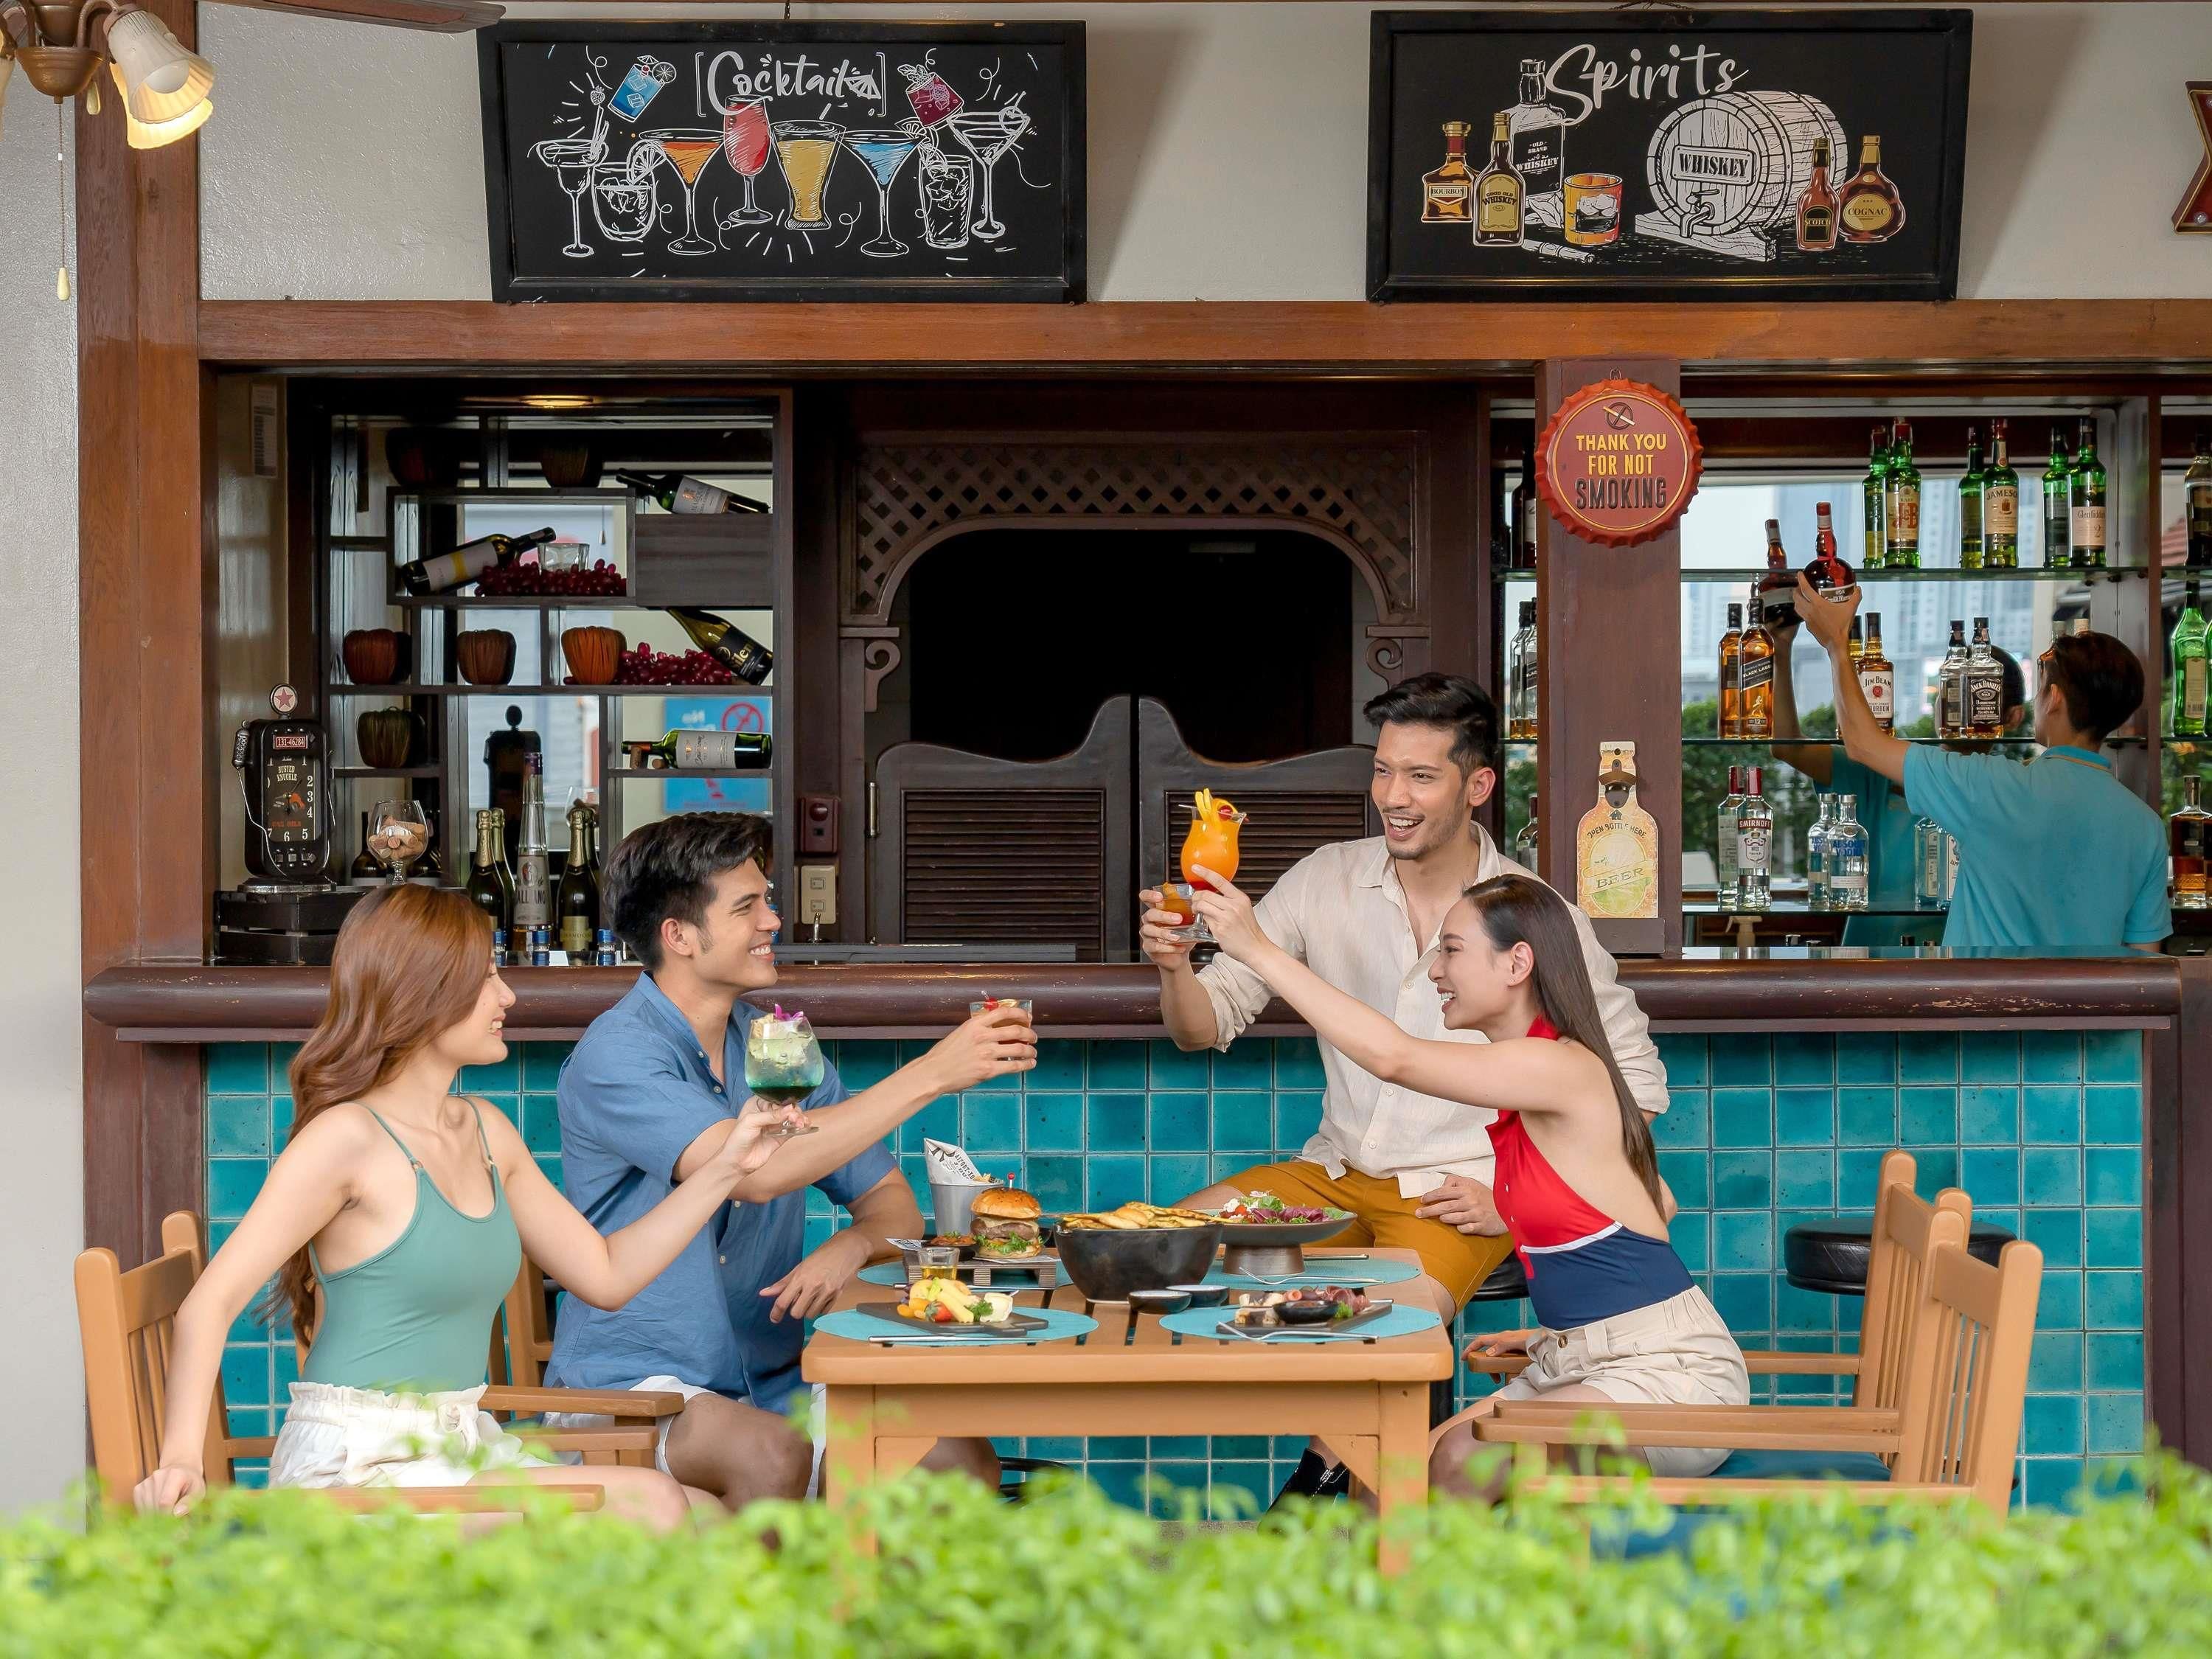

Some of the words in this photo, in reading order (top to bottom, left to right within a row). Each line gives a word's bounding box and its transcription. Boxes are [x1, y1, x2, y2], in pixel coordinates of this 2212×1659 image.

[1545, 44, 1749, 126] Spirits
[1516, 157, 1559, 170] WHISKEY
[1679, 153, 1748, 177] WHISKEY
[1482, 195, 1517, 206] WHISKEY
[1848, 207, 1888, 215] COGNAC
[1575, 434, 1630, 451] THANK
[1632, 433, 1666, 451] YOU
[1587, 454, 1618, 476] FOR
[1624, 453, 1654, 475] NOT
[1575, 476, 1666, 510] SMOKING
[1986, 489, 2017, 500] JAMESO
[1863, 678, 1874, 688] JIM
[1876, 675, 1892, 688] BEAM
[1971, 682, 1983, 693] JACK
[278, 765, 295, 773] BUSTED
[276, 773, 298, 782] KNUCKLE
[307, 775, 313, 787] 2
[307, 790, 313, 803] 3
[307, 807, 313, 818] 4
[1739, 820, 1770, 828] SMIRNOFF
[283, 831, 291, 842] 6
[302, 828, 308, 840] 5
[1596, 867, 1644, 888] BEER
